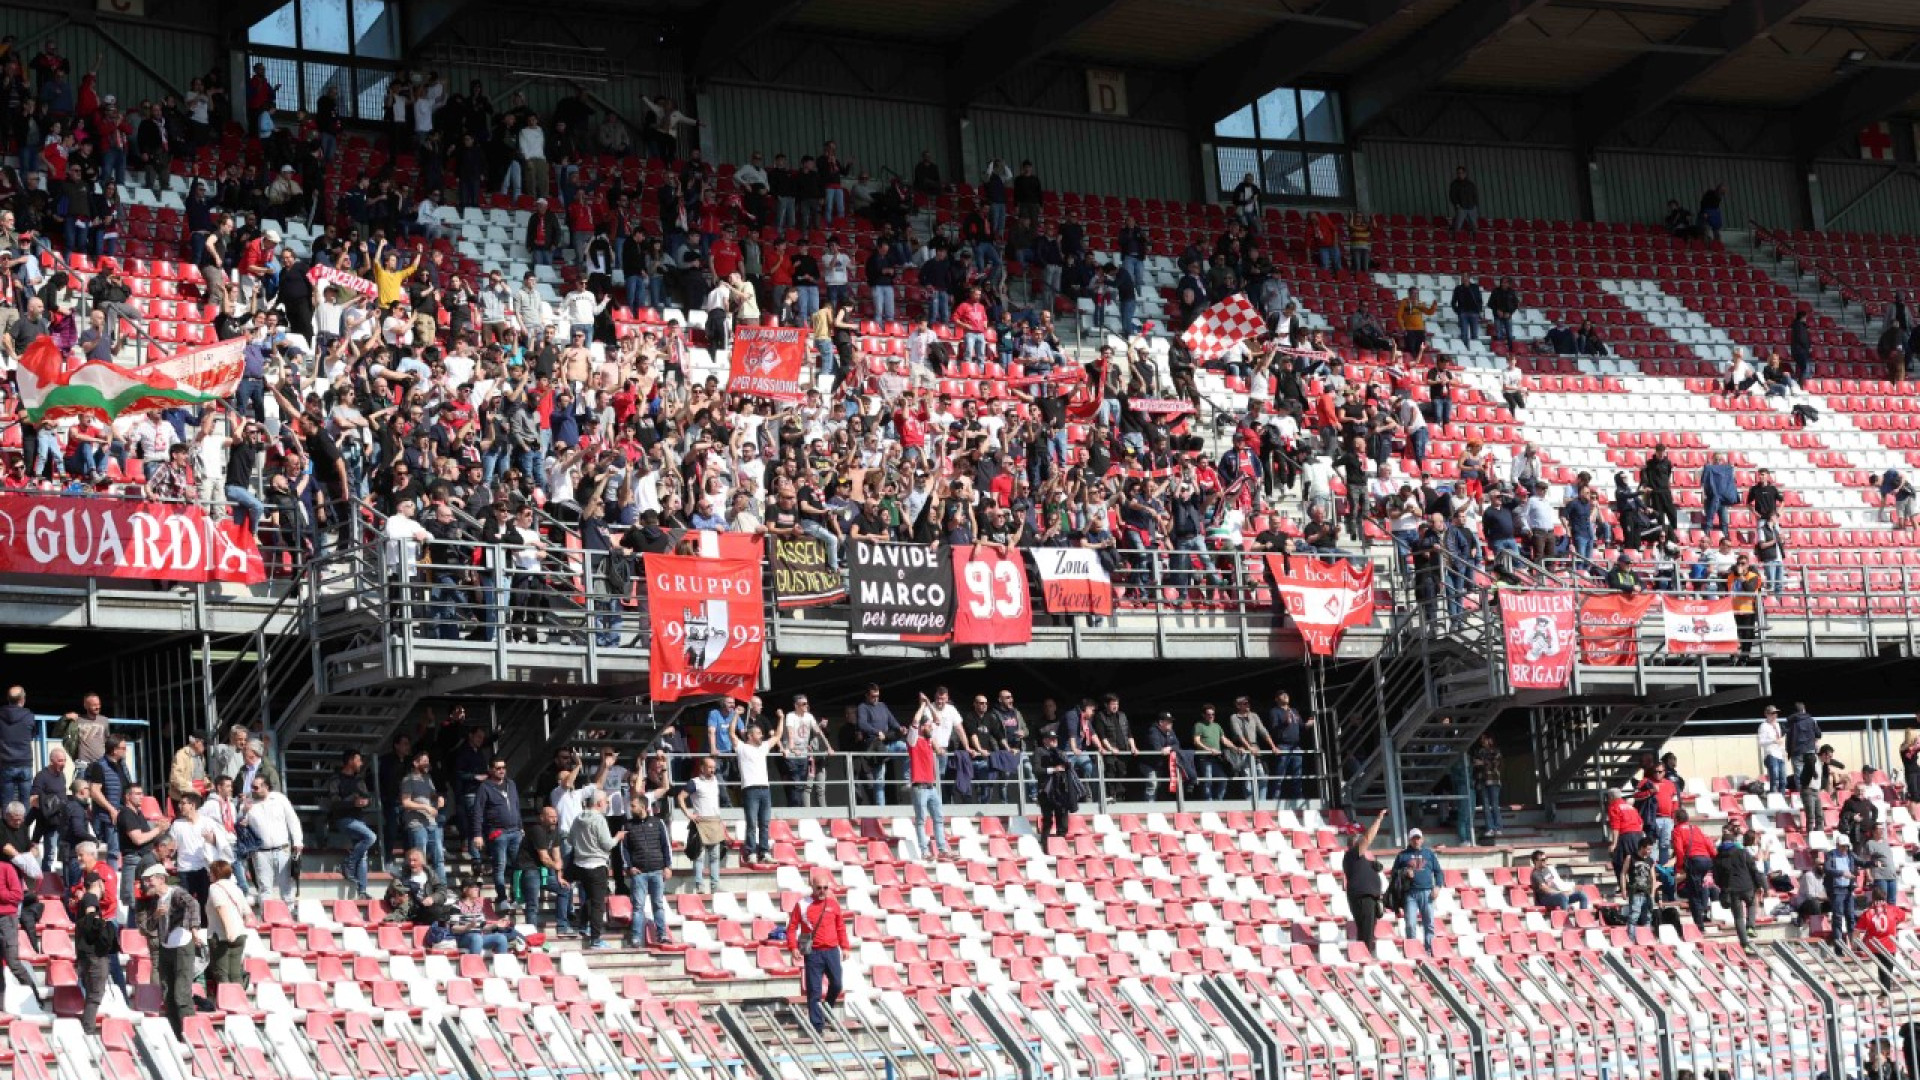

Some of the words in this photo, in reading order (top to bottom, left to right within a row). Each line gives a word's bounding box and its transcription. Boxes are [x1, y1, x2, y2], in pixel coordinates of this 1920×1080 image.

[1098, 84, 1117, 112] D
[752, 377, 800, 393] PASSIONE
[27, 505, 247, 574] GUARDIA
[857, 542, 939, 568] DAVIDE
[1055, 549, 1090, 575] Zona
[657, 573, 751, 596] GRUPPO
[860, 580, 946, 607] MARCO
[964, 560, 1024, 619] 93
[862, 610, 886, 628] per
[890, 611, 946, 632] sempre
[731, 624, 762, 649] 92
[1871, 913, 1888, 933] 10
